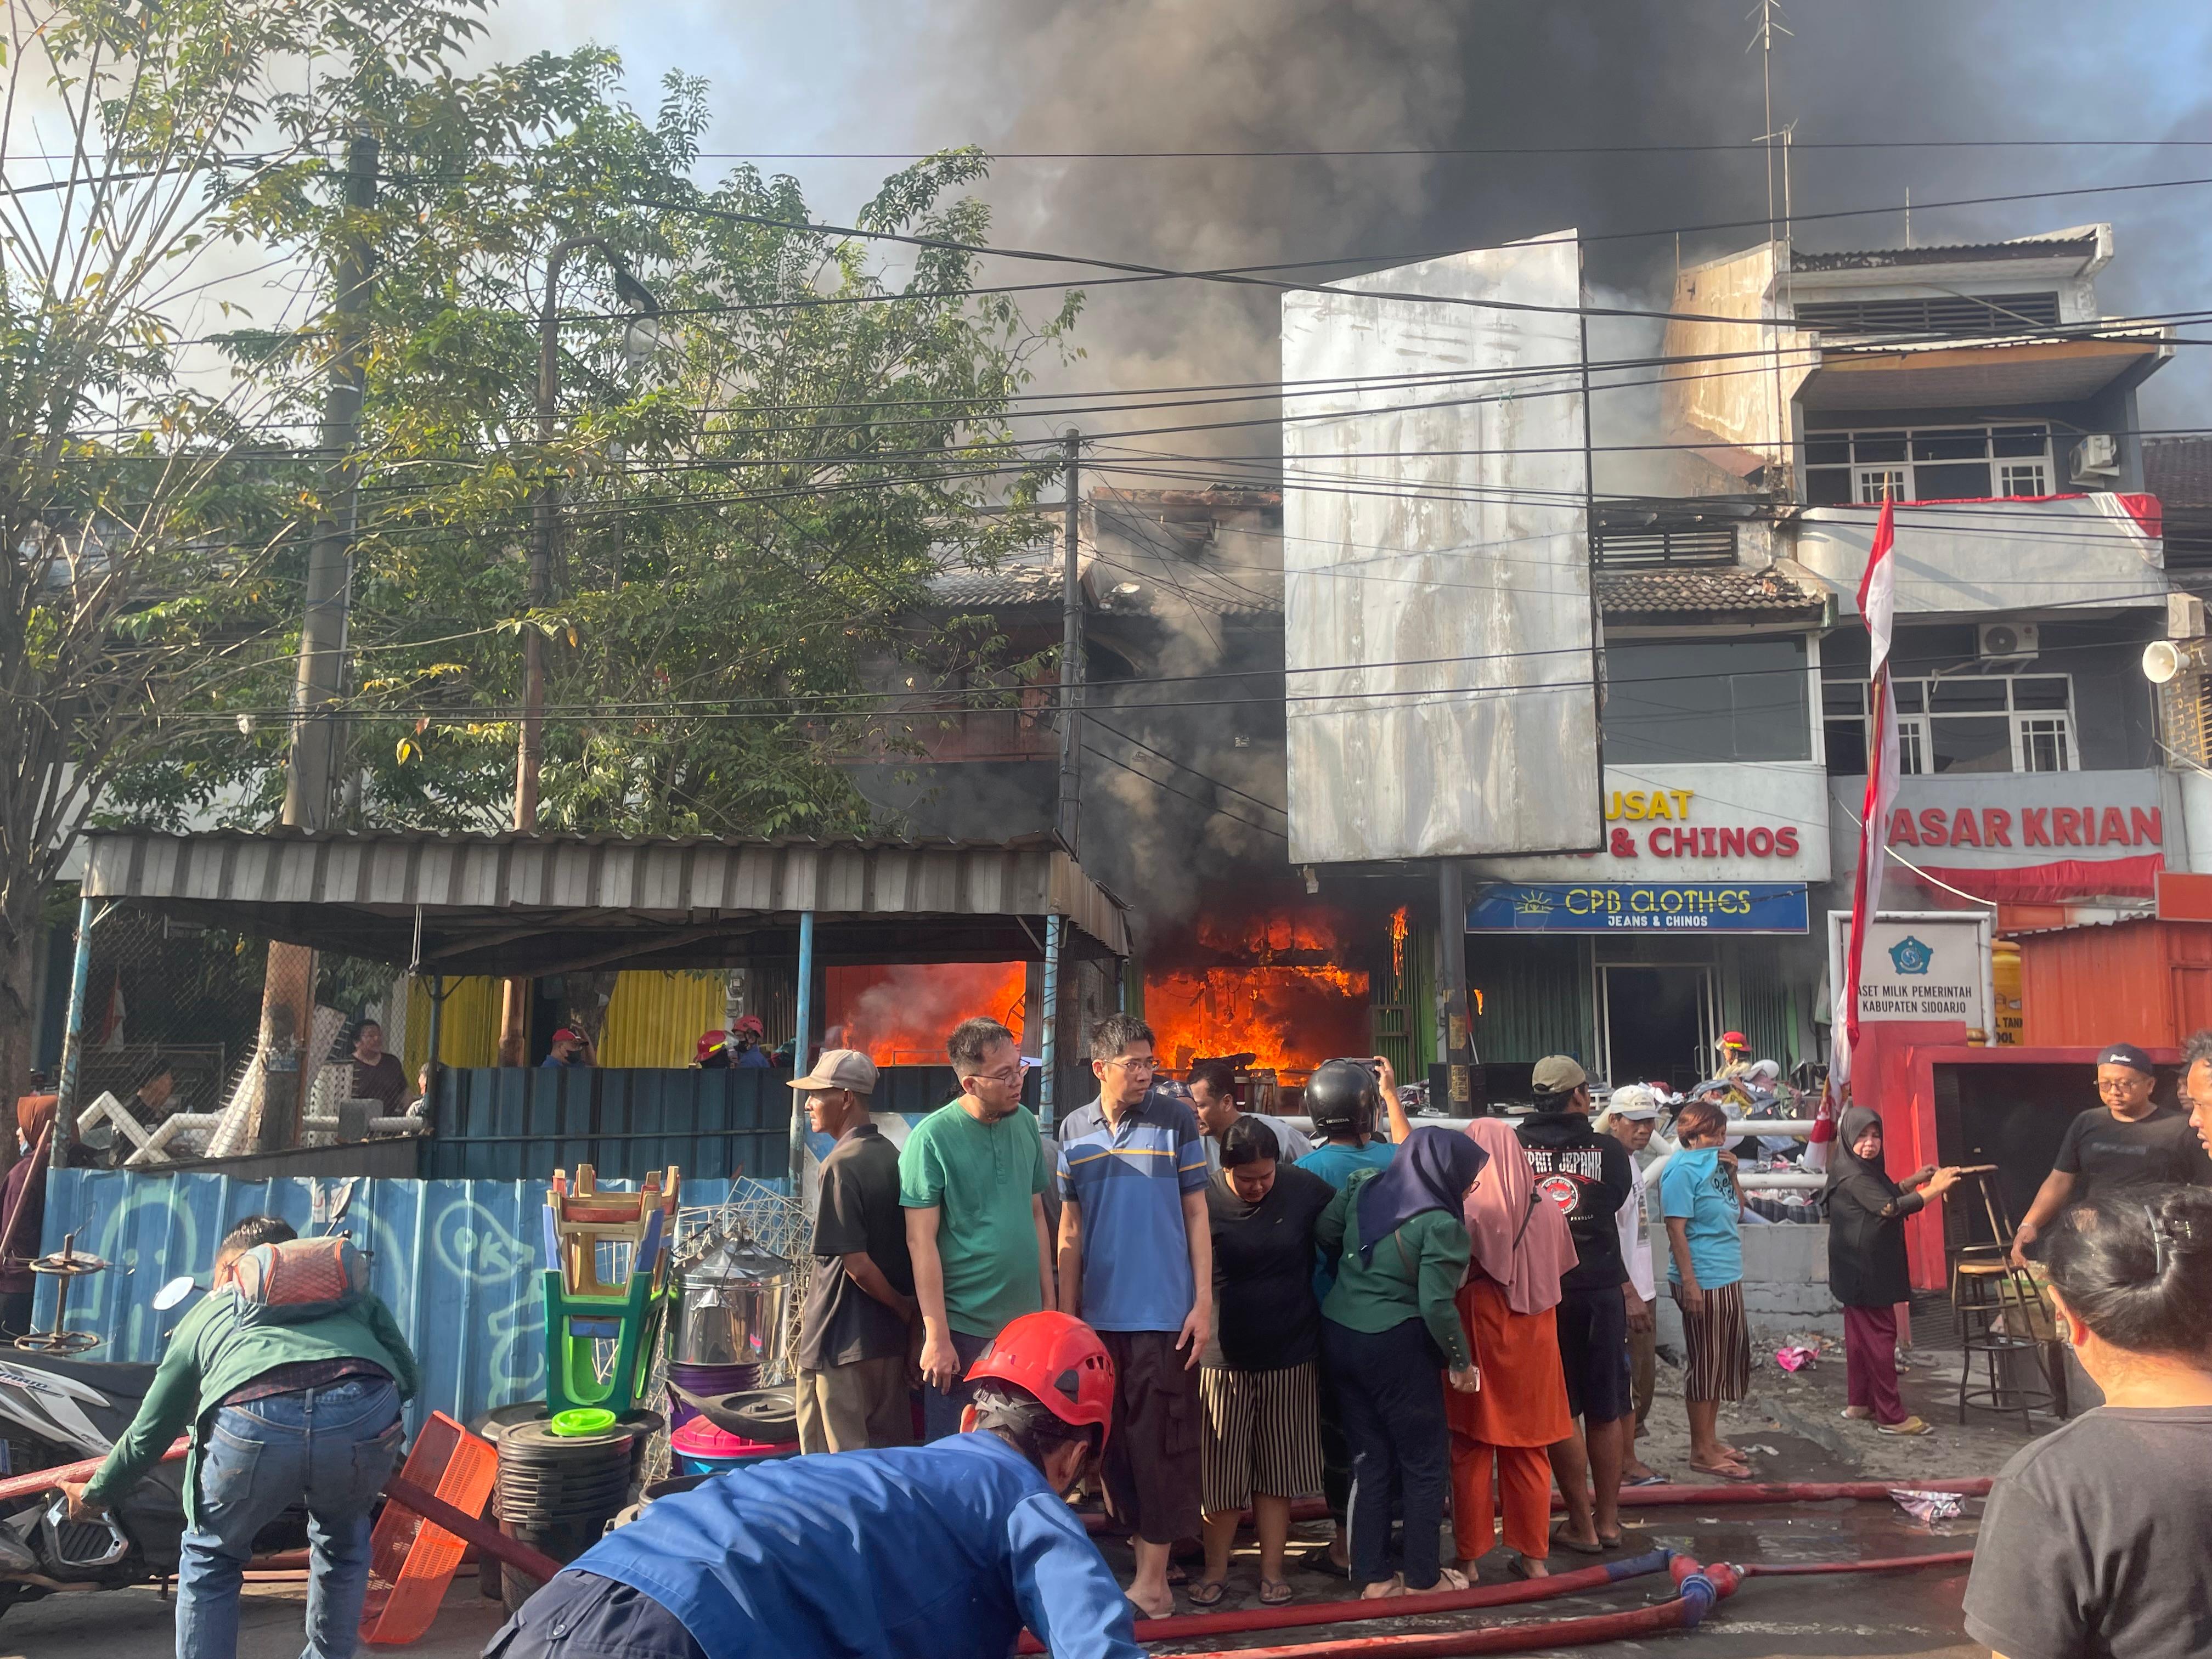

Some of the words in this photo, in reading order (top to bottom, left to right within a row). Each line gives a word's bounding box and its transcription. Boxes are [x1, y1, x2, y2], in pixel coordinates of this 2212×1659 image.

[1885, 808, 2012, 847] ASAR
[2022, 806, 2163, 846] KRIAN
[1611, 827, 1638, 857] &
[1648, 827, 1799, 857] CHINOS
[1565, 888, 1621, 915] CPB
[1630, 889, 1751, 914] CLOTHES
[1608, 916, 1648, 927] JEANS
[1652, 916, 1661, 927] &
[1666, 916, 1708, 927] CHINOS
[1882, 985, 1909, 997] MILIK
[1912, 986, 1972, 998] PEMERINTAH
[1863, 1000, 1918, 1013] KABUPATEN
[1922, 1001, 1966, 1013] SIDOARJO
[1524, 1150, 1553, 1173] PRIT
